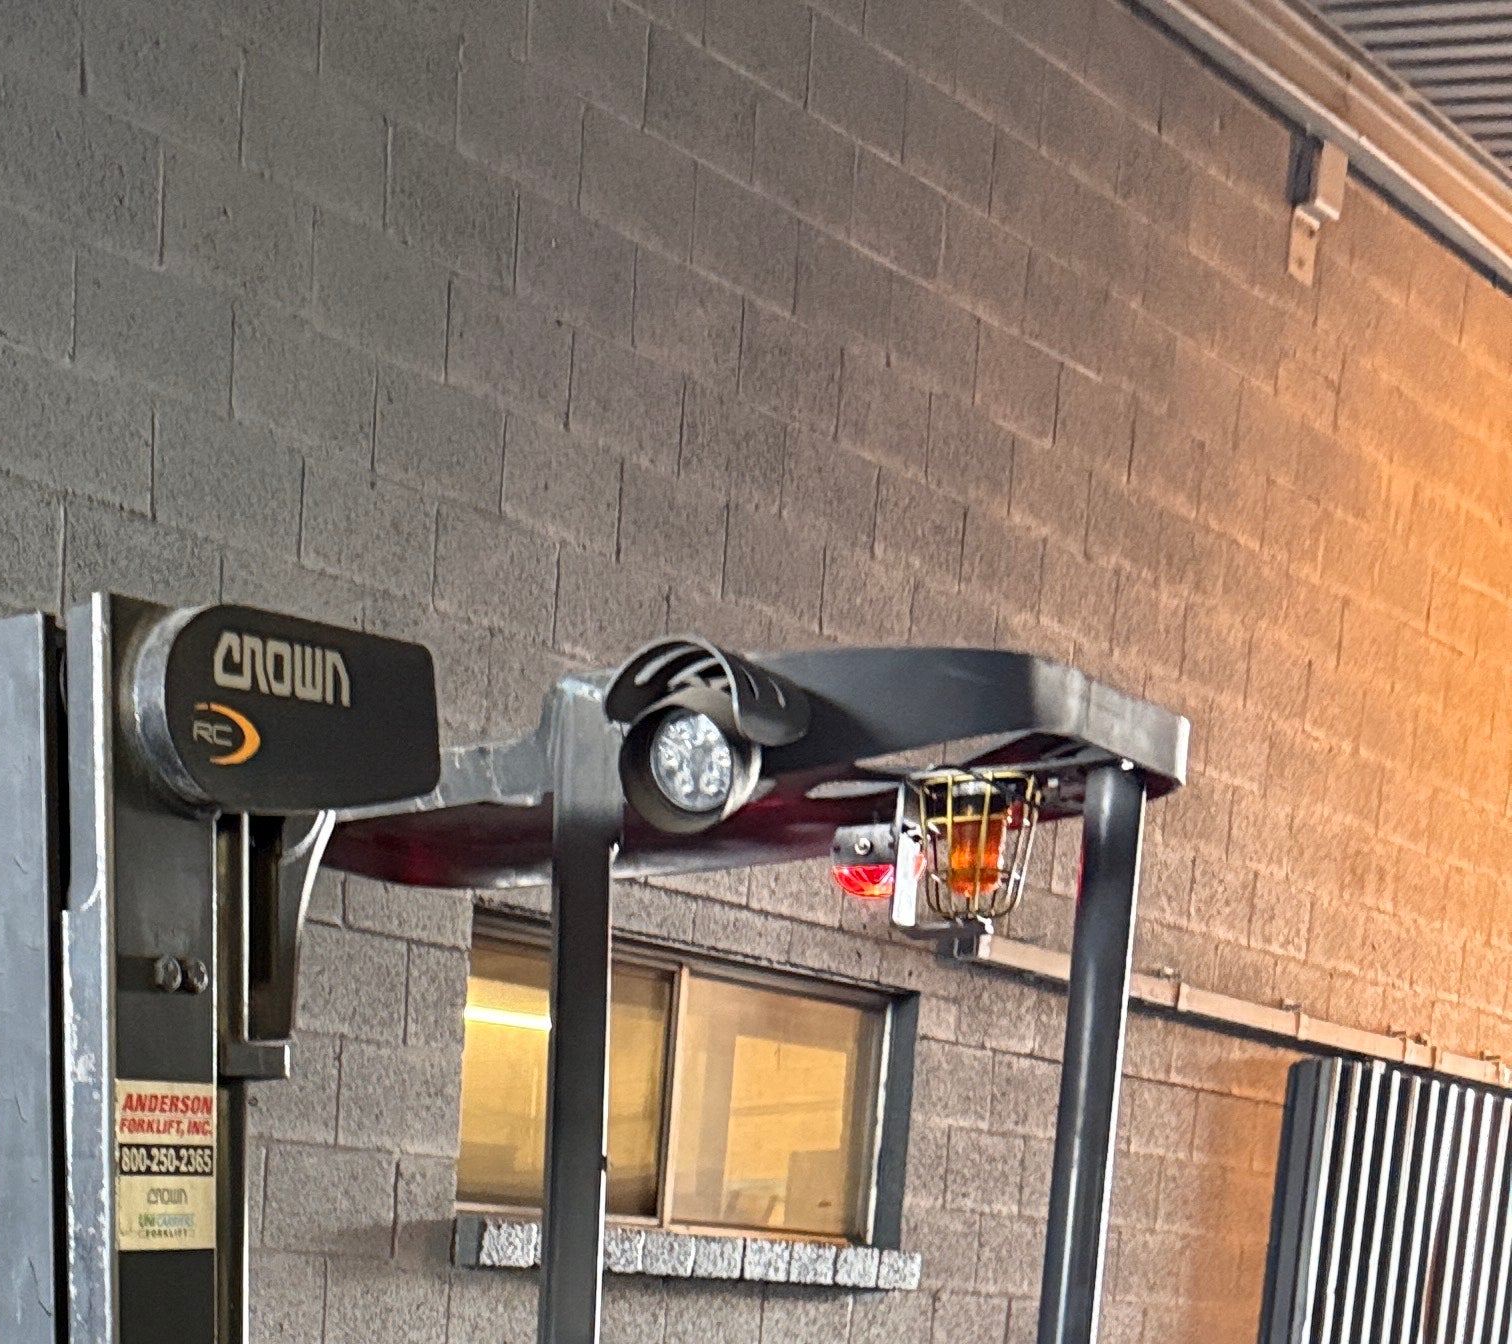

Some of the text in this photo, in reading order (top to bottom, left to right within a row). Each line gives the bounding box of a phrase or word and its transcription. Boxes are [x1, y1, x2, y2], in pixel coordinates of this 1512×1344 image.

[213, 631, 351, 708] CROWN
[192, 719, 233, 747] RC
[122, 1093, 213, 1114] ANDERSON
[120, 1117, 185, 1138] FORKLIFT,
[121, 1147, 212, 1173] 800-250-2365
